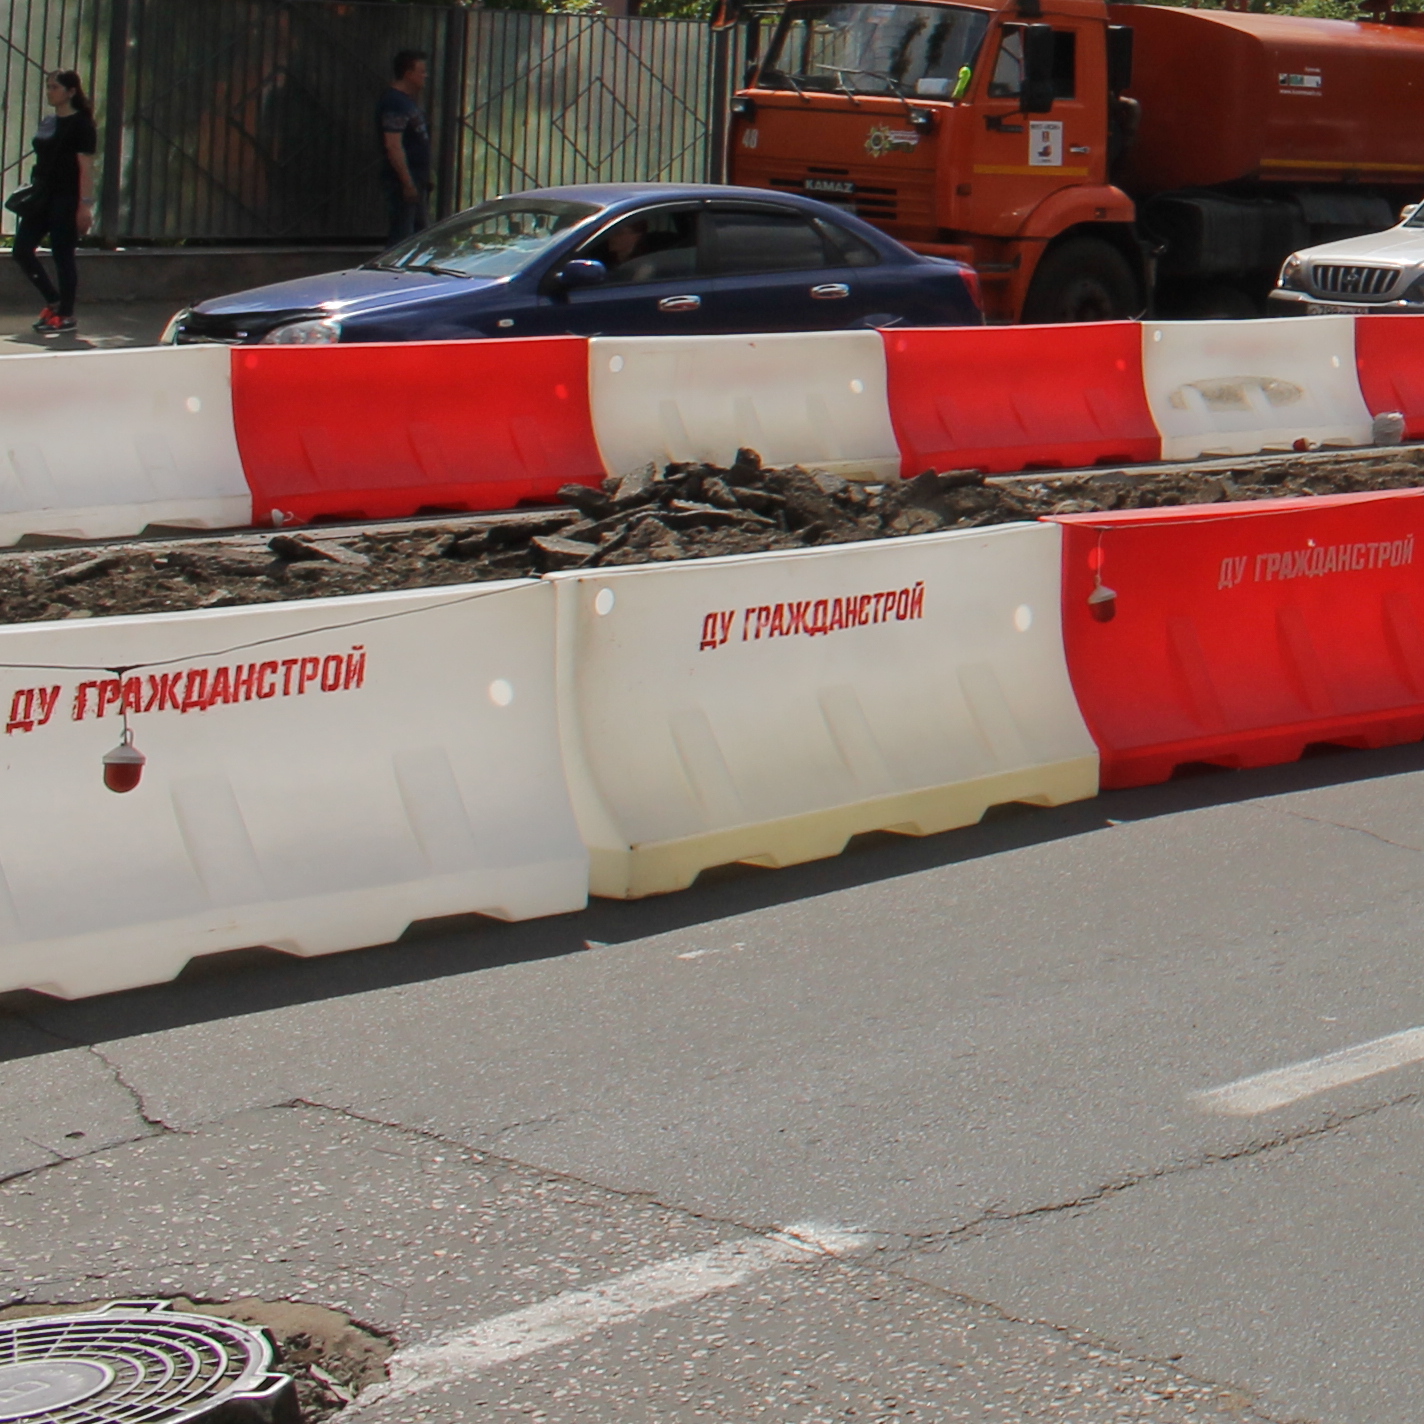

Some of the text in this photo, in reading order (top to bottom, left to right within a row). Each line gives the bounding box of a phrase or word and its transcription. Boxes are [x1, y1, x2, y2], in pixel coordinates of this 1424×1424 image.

[805, 179, 854, 194] KAMAZ
[1217, 533, 1415, 590] ДУ ГРАЖДАНСТРОЙ
[699, 580, 925, 652] ДУ ГРАЖДАНСТРОЙ
[5, 644, 367, 736] ДУ ГРАЖДАНСТРОЙ
